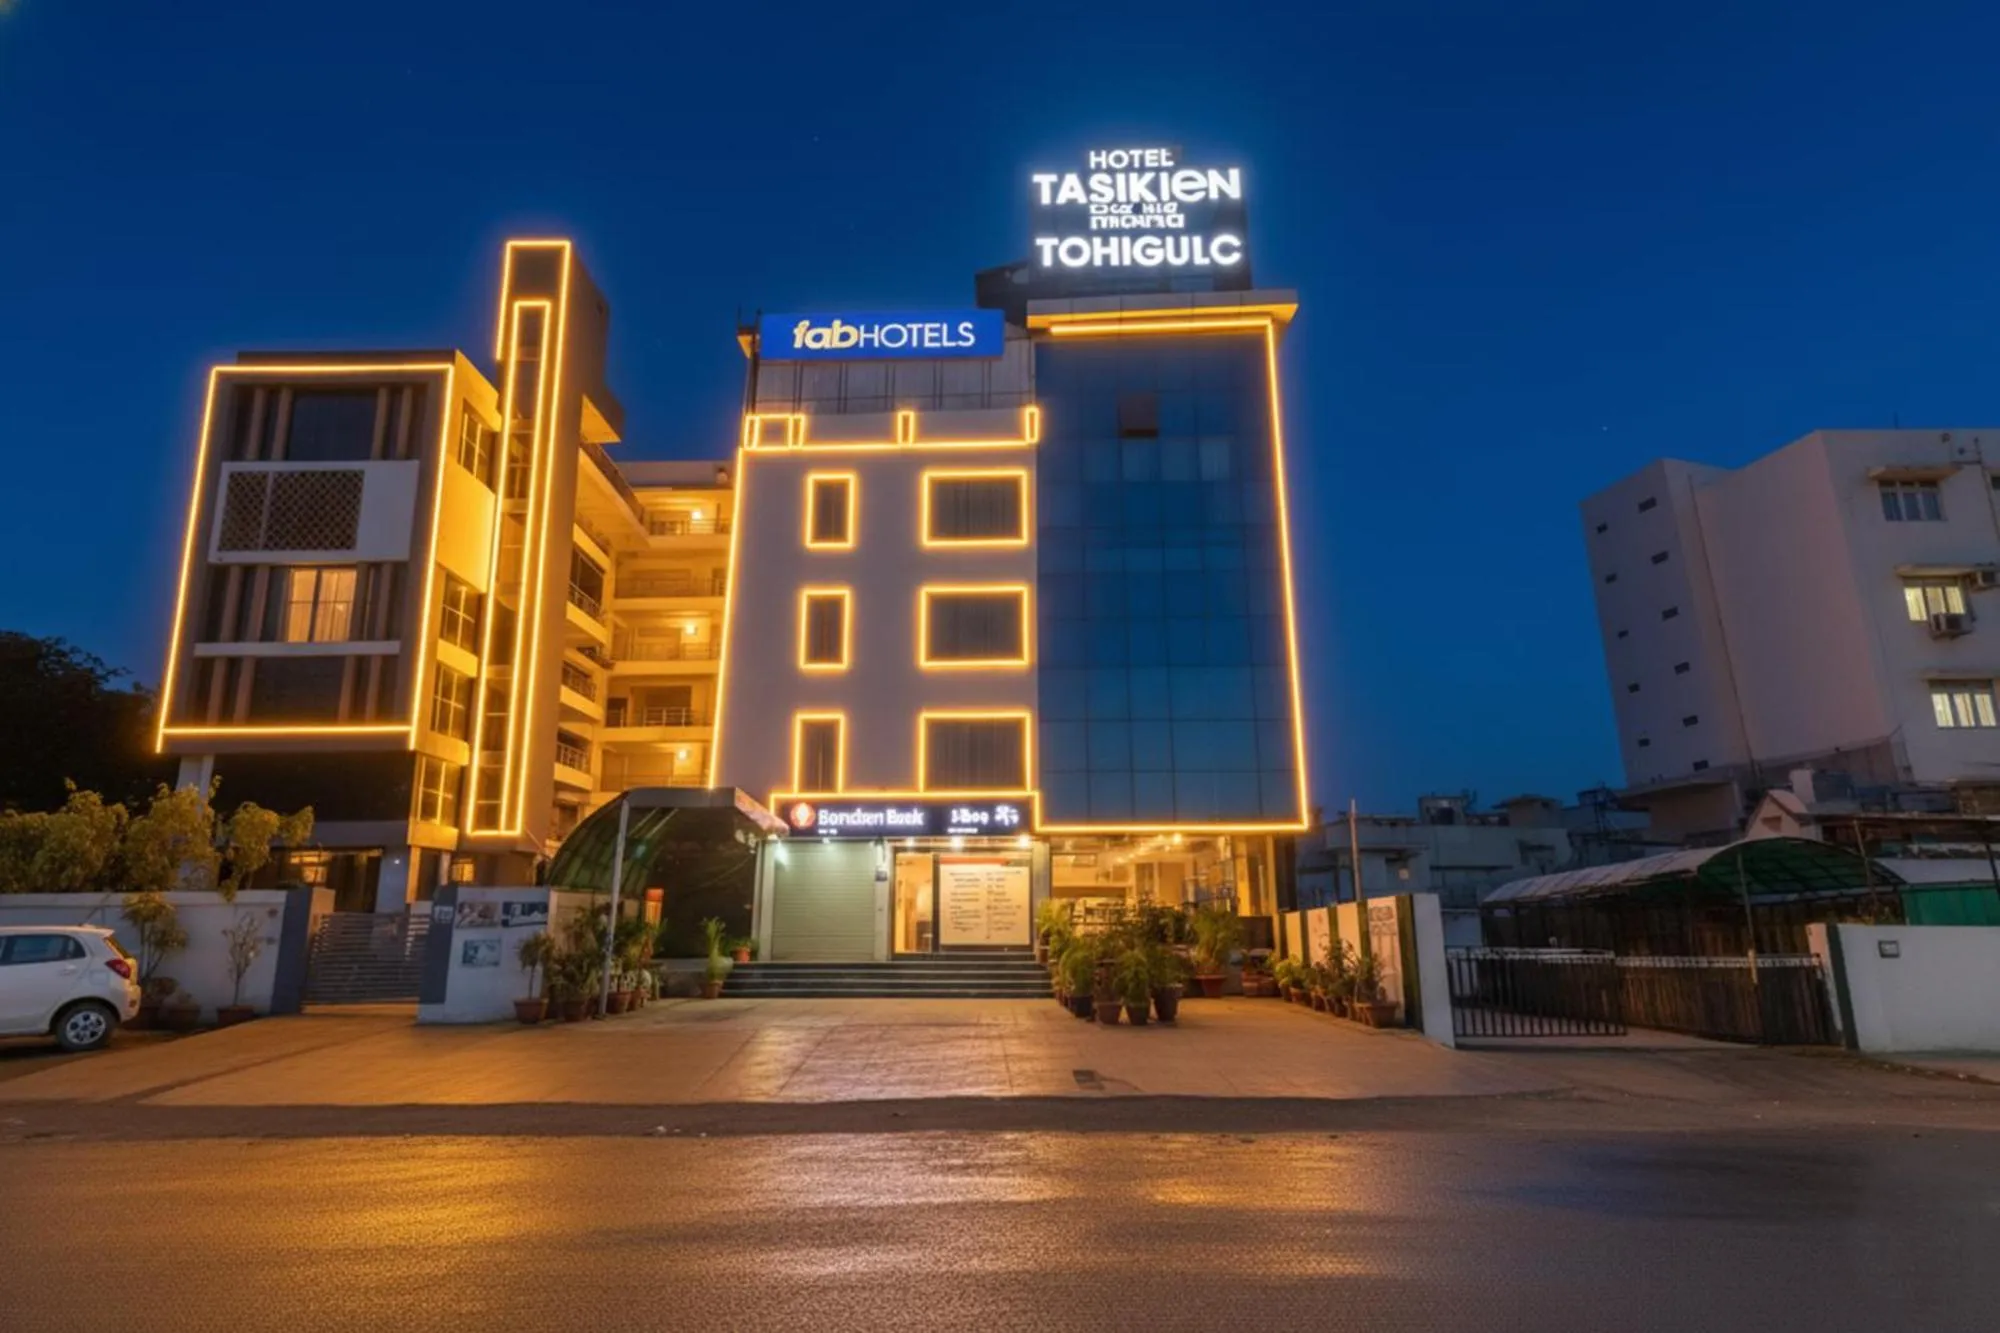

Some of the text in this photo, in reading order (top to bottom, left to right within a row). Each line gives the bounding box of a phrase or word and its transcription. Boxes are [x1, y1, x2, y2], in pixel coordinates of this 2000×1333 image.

[1089, 148, 1175, 170] HOTEL
[1035, 234, 1242, 268] TOHIGULC
[793, 319, 976, 350] fabHOTELS
